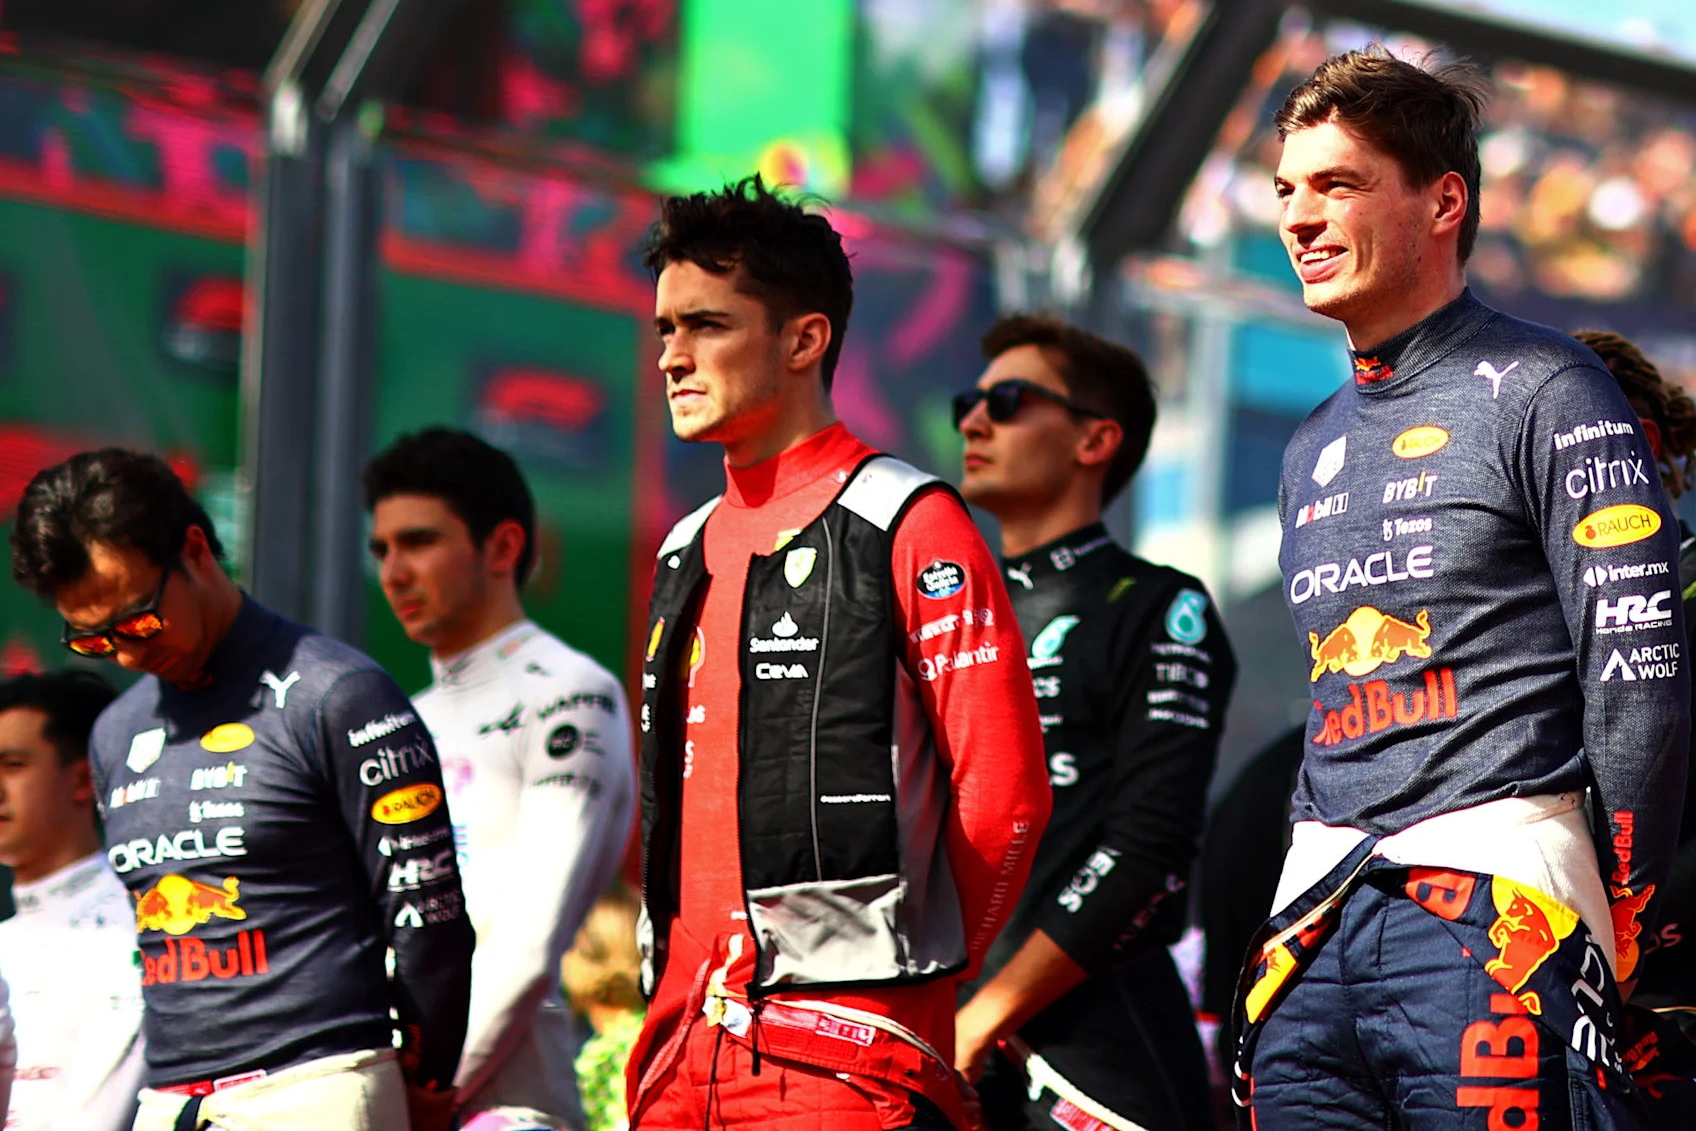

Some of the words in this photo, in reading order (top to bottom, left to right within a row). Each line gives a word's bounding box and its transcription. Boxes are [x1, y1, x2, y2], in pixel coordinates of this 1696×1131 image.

[1553, 420, 1635, 450] infinitum
[1382, 471, 1438, 504] BYBIT
[1565, 450, 1650, 499] citrix
[1296, 494, 1332, 529] Mobil
[1597, 513, 1652, 537] RAUCH
[1394, 518, 1433, 536] Tezos
[1290, 545, 1434, 604] ORACLE
[1607, 561, 1669, 582] inter.mx
[1595, 590, 1672, 628] HRC
[1634, 619, 1673, 632] RACING
[749, 636, 819, 654] Santander
[1629, 643, 1681, 664] ARCTIC
[1638, 661, 1679, 680] WOLF
[107, 826, 249, 874] ORACLE
